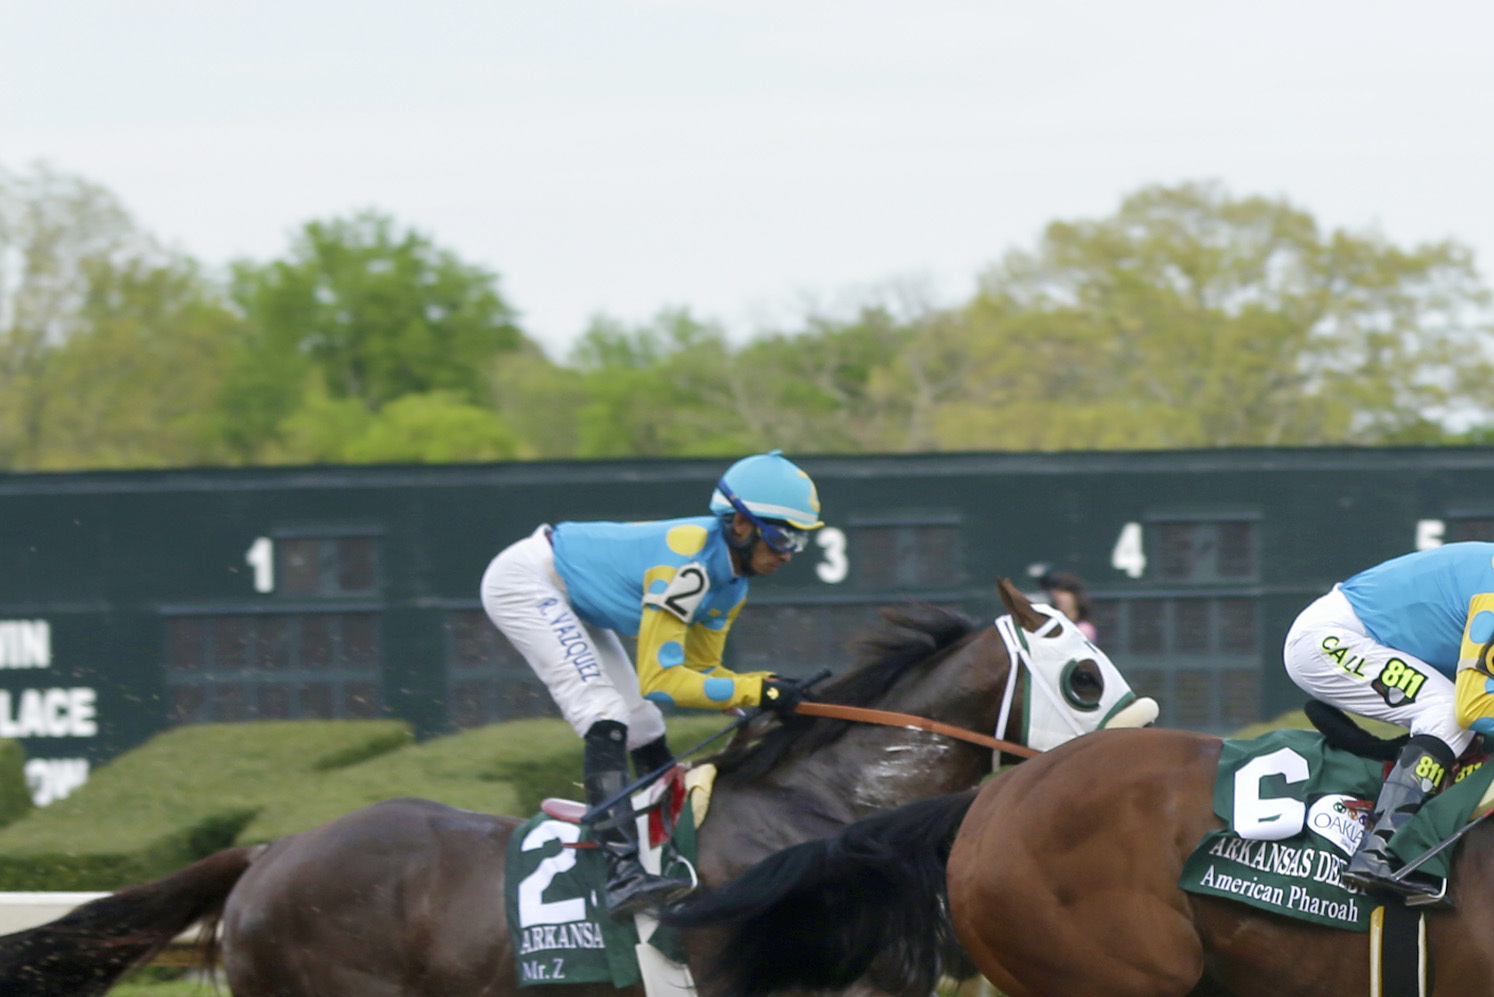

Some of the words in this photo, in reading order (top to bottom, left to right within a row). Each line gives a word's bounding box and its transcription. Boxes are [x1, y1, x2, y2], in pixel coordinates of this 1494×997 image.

[815, 527, 848, 583] 3
[1112, 522, 1146, 578] 4
[1415, 519, 1445, 551] 5
[245, 536, 273, 594] 1
[664, 568, 704, 617] 2
[0, 620, 51, 669] IN
[550, 612, 602, 682] VAZQUEZ
[1322, 636, 1365, 678] CALL
[1381, 658, 1426, 698] 811
[1233, 746, 1310, 841] 6
[1416, 756, 1445, 787] 811
[518, 820, 586, 928] 2
[1209, 836, 1315, 878] ARKANSAS
[1200, 864, 1285, 906] American
[1286, 885, 1359, 922] Pharoah
[520, 922, 606, 955] ARKANSA
[522, 961, 550, 981] Mr.
[552, 958, 565, 979] Z
